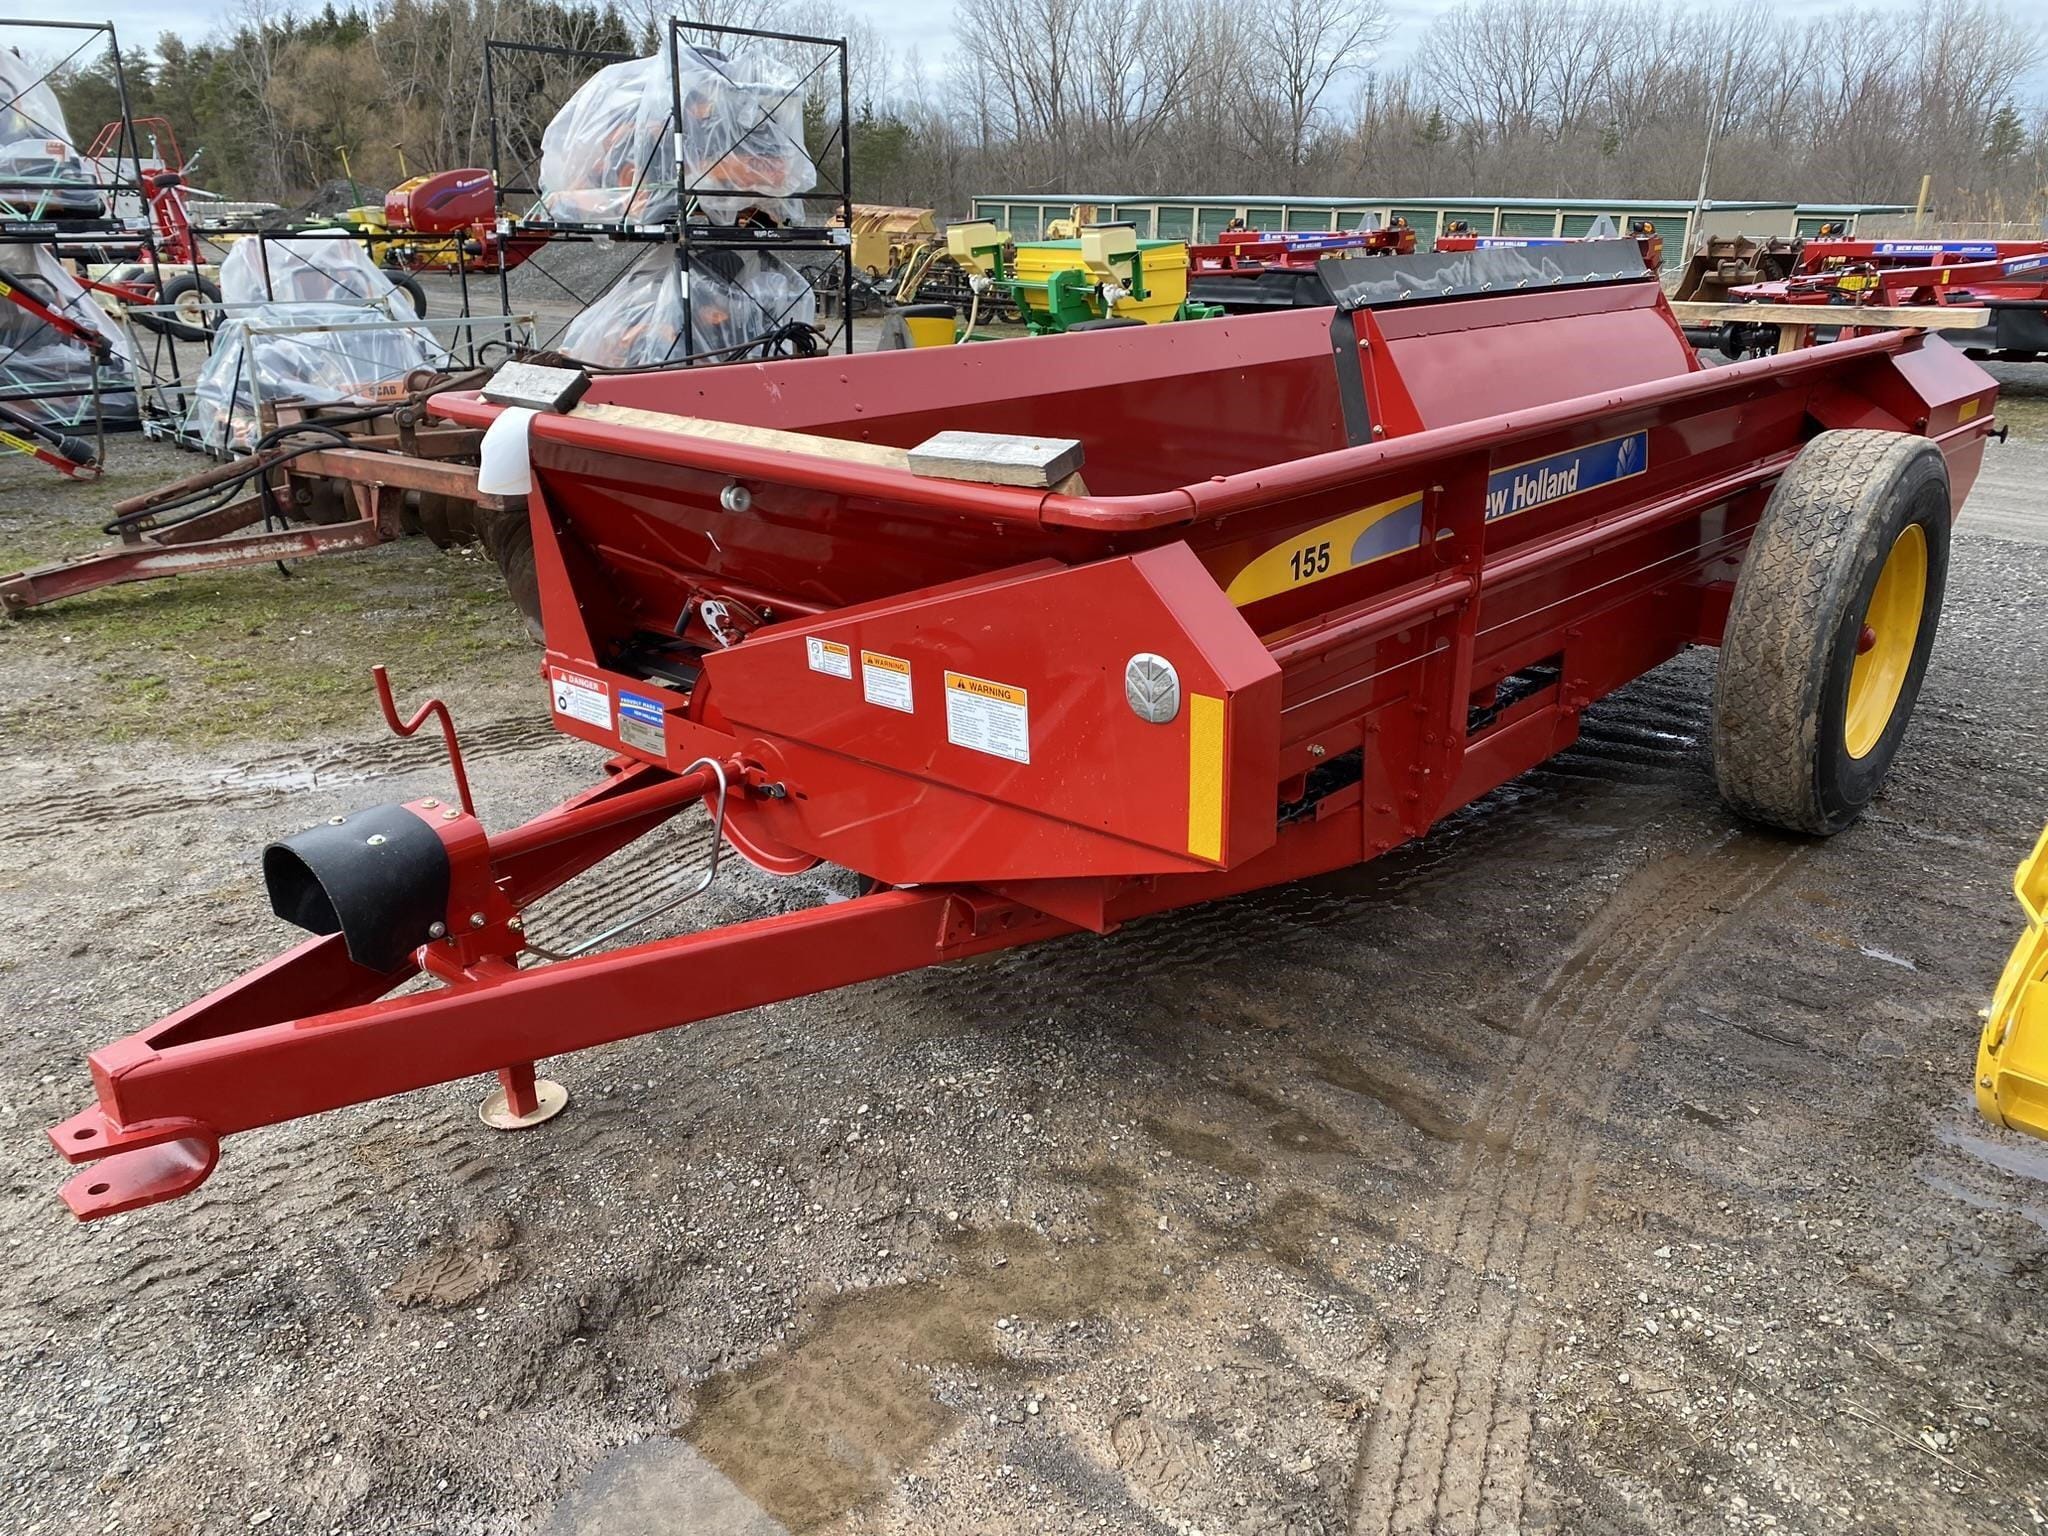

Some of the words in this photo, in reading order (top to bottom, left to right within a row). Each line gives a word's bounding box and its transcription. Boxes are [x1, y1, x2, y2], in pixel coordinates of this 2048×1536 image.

[368, 385, 397, 396] SCAG
[1511, 458, 1580, 511] Holland
[1290, 541, 1330, 581] 155
[873, 658, 905, 671] WARNING
[568, 674, 599, 691] DANGER
[968, 680, 1012, 700] WARNING
